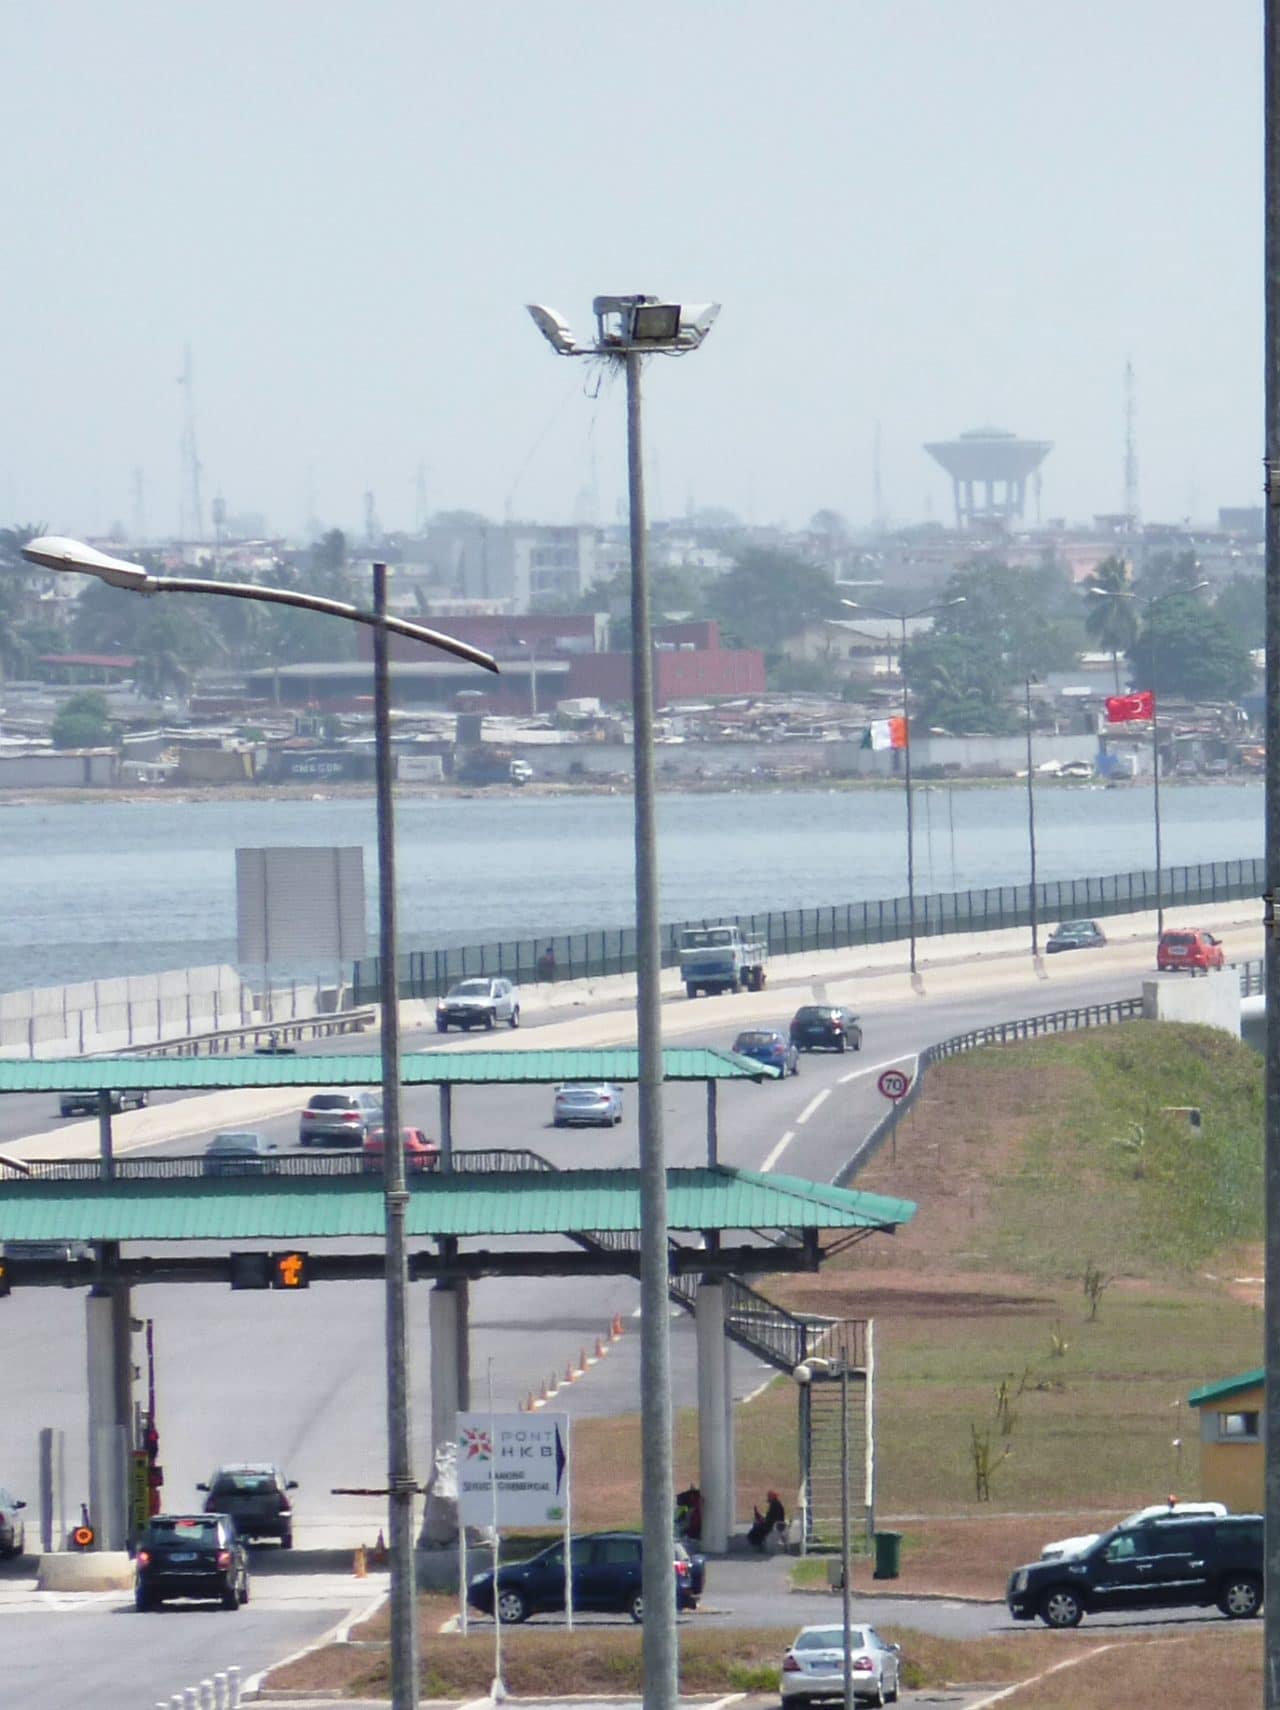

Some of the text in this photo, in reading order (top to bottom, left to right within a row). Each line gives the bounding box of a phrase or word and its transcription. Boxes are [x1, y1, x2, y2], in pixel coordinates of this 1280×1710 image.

[885, 1079, 903, 1091] 70
[501, 1431, 554, 1441] PONT
[501, 1446, 553, 1457] HKB
